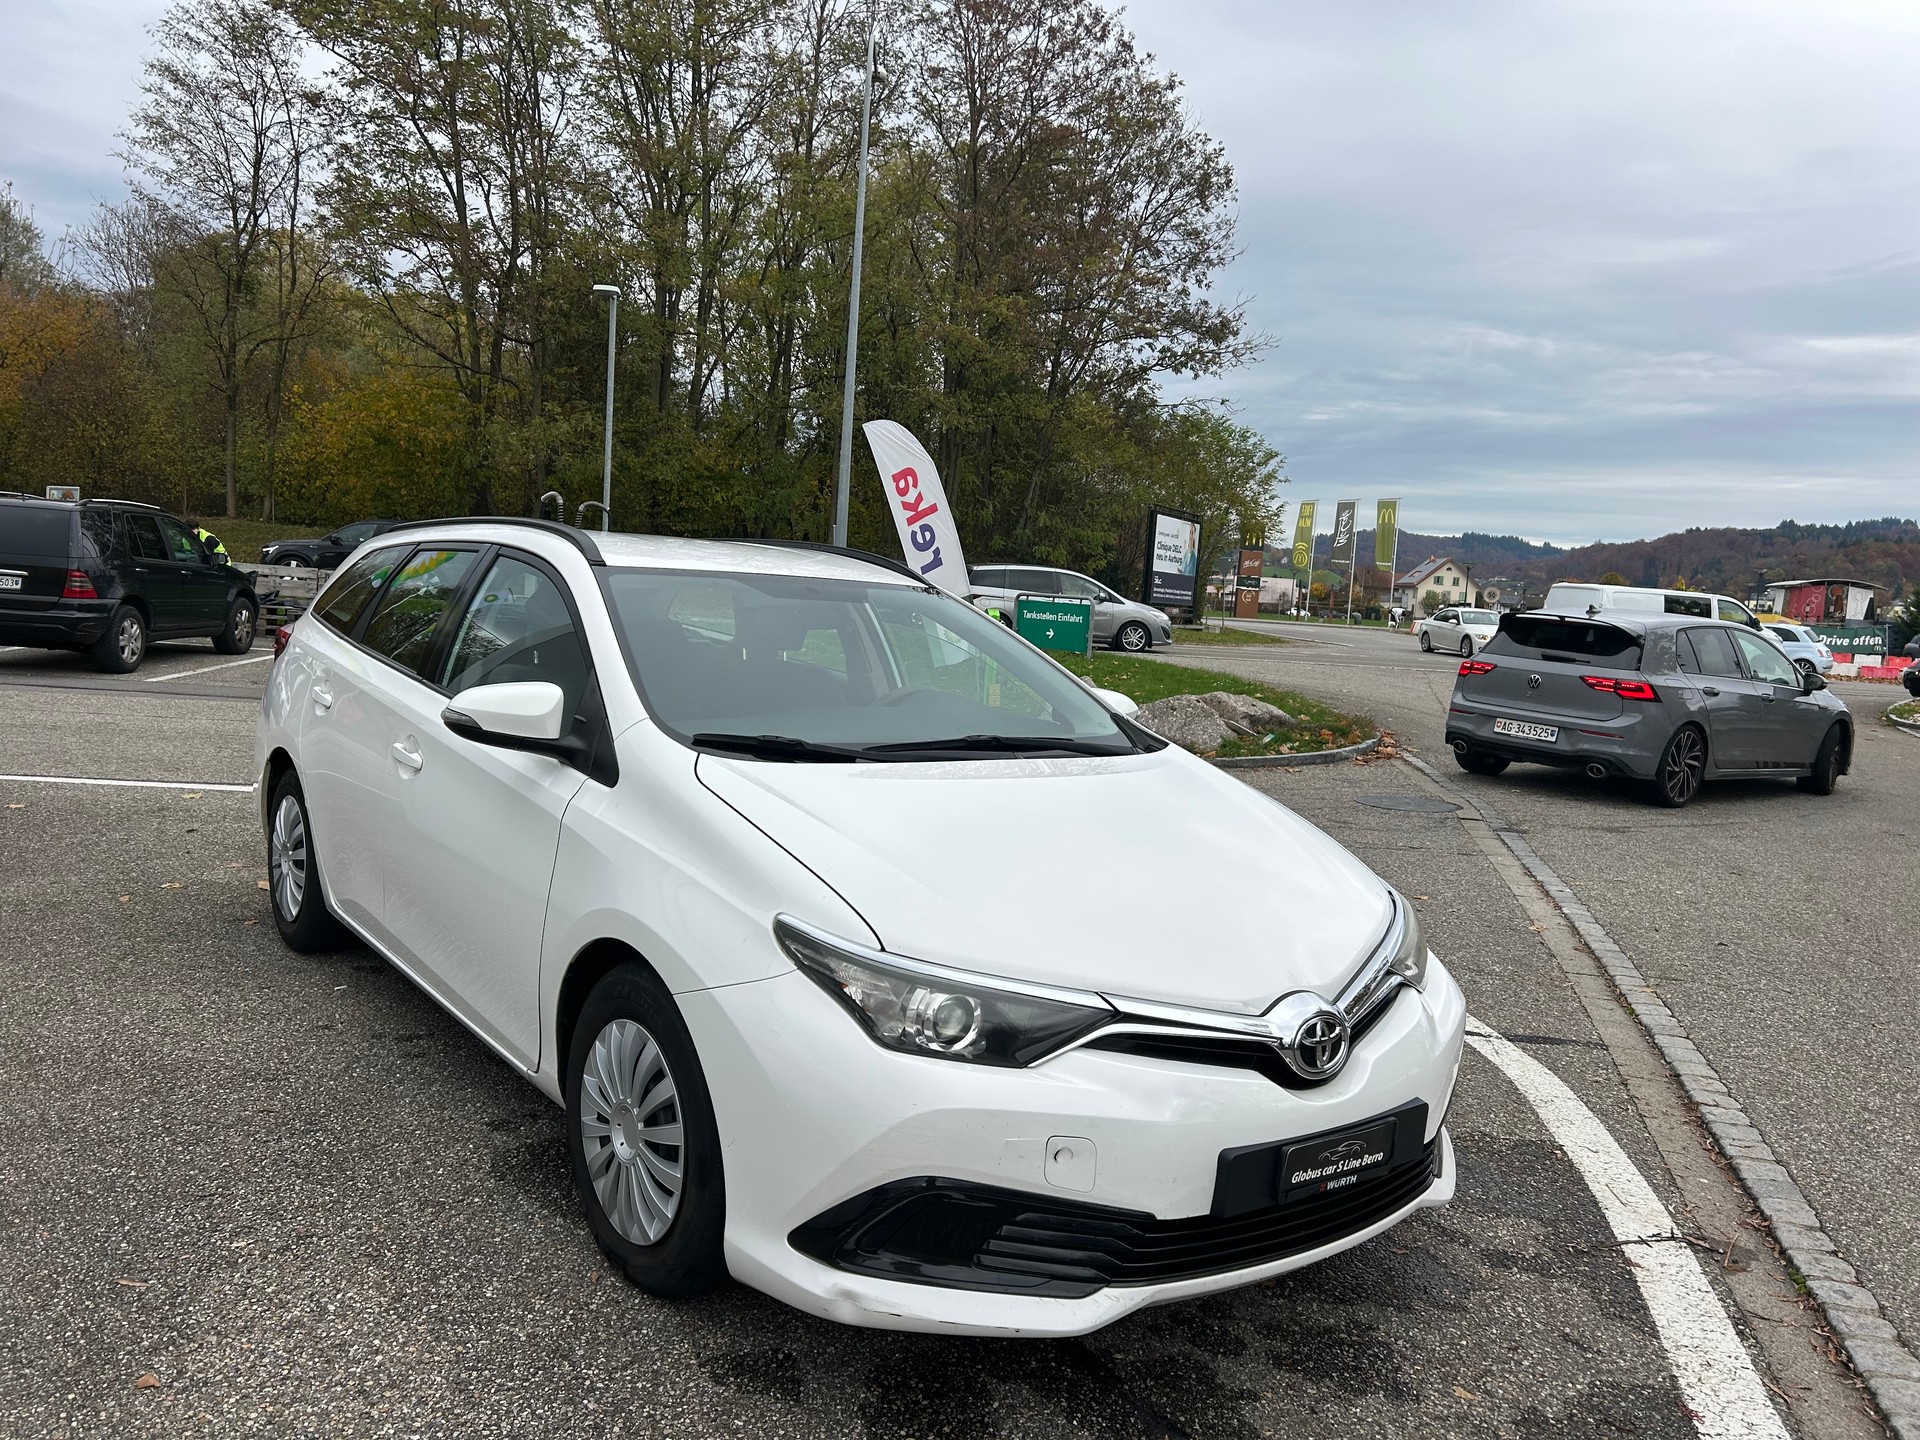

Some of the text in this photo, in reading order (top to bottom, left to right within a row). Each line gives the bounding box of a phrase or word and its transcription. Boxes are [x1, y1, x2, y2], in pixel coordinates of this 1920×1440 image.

[891, 466, 943, 575] reka
[1023, 609, 1083, 624] Tankstellen Einfahrt
[1819, 634, 1882, 646] Drive offen
[1291, 1168, 1322, 1184] Globus
[1322, 1164, 1338, 1176] car
[1343, 1157, 1361, 1171] Line
[1361, 1151, 1384, 1166] Berro
[1326, 1174, 1358, 1190] WÜRTH
